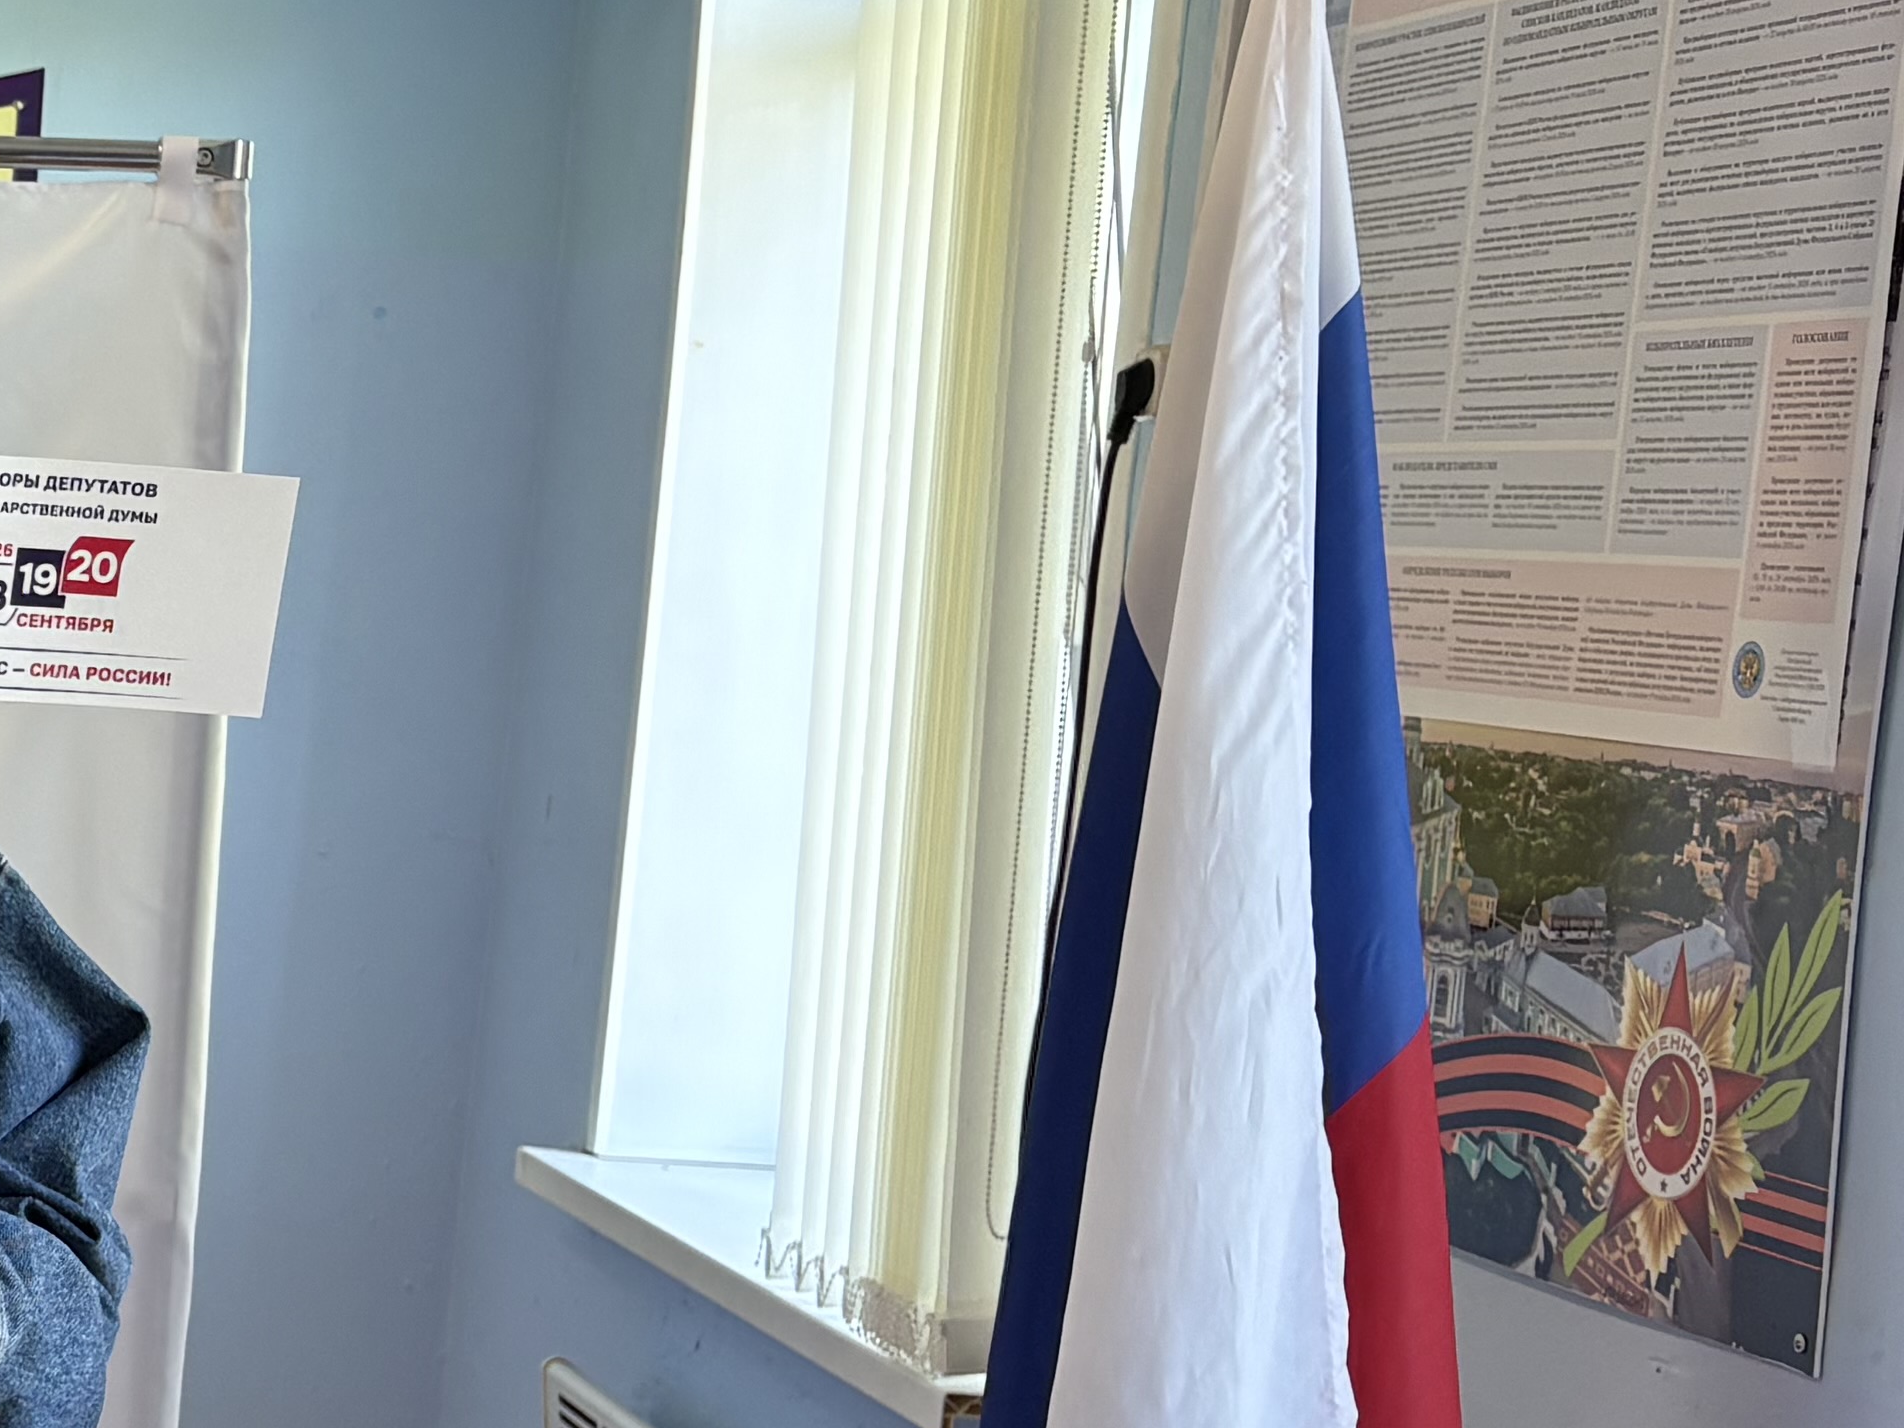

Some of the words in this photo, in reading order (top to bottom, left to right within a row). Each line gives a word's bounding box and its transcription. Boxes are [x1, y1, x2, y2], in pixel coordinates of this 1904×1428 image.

[44, 475, 158, 498] ДЕПУТАТОВ
[108, 508, 158, 525] ДУМЫ
[19, 563, 57, 596] 19
[67, 549, 119, 584] 20
[16, 613, 114, 634] СЕНТЯБРЯ
[30, 661, 81, 681] СИЛА
[86, 666, 172, 687] РОССИИ!
